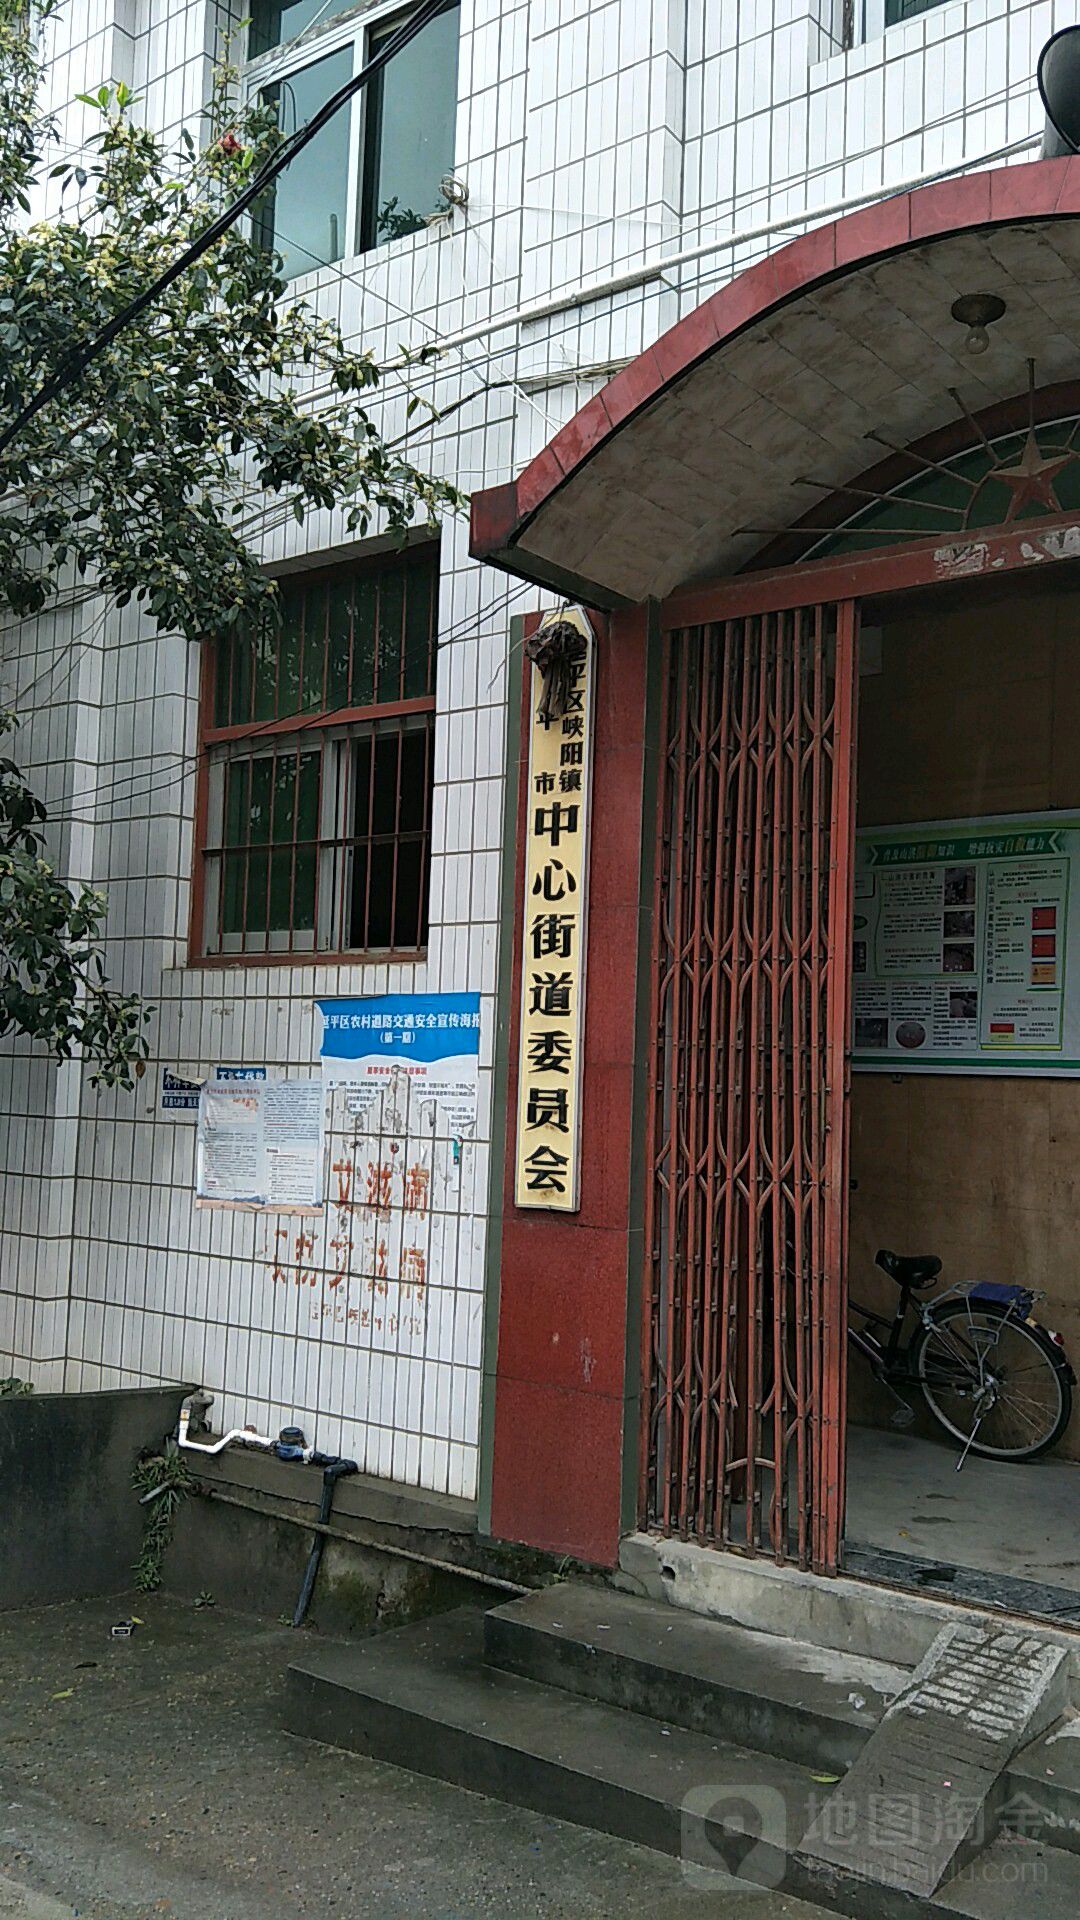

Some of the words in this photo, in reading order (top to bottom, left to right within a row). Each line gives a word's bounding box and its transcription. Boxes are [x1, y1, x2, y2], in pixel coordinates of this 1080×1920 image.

[558, 649, 587, 794] 平区峡阳镇
[524, 801, 579, 1193] 中心街道委员会
